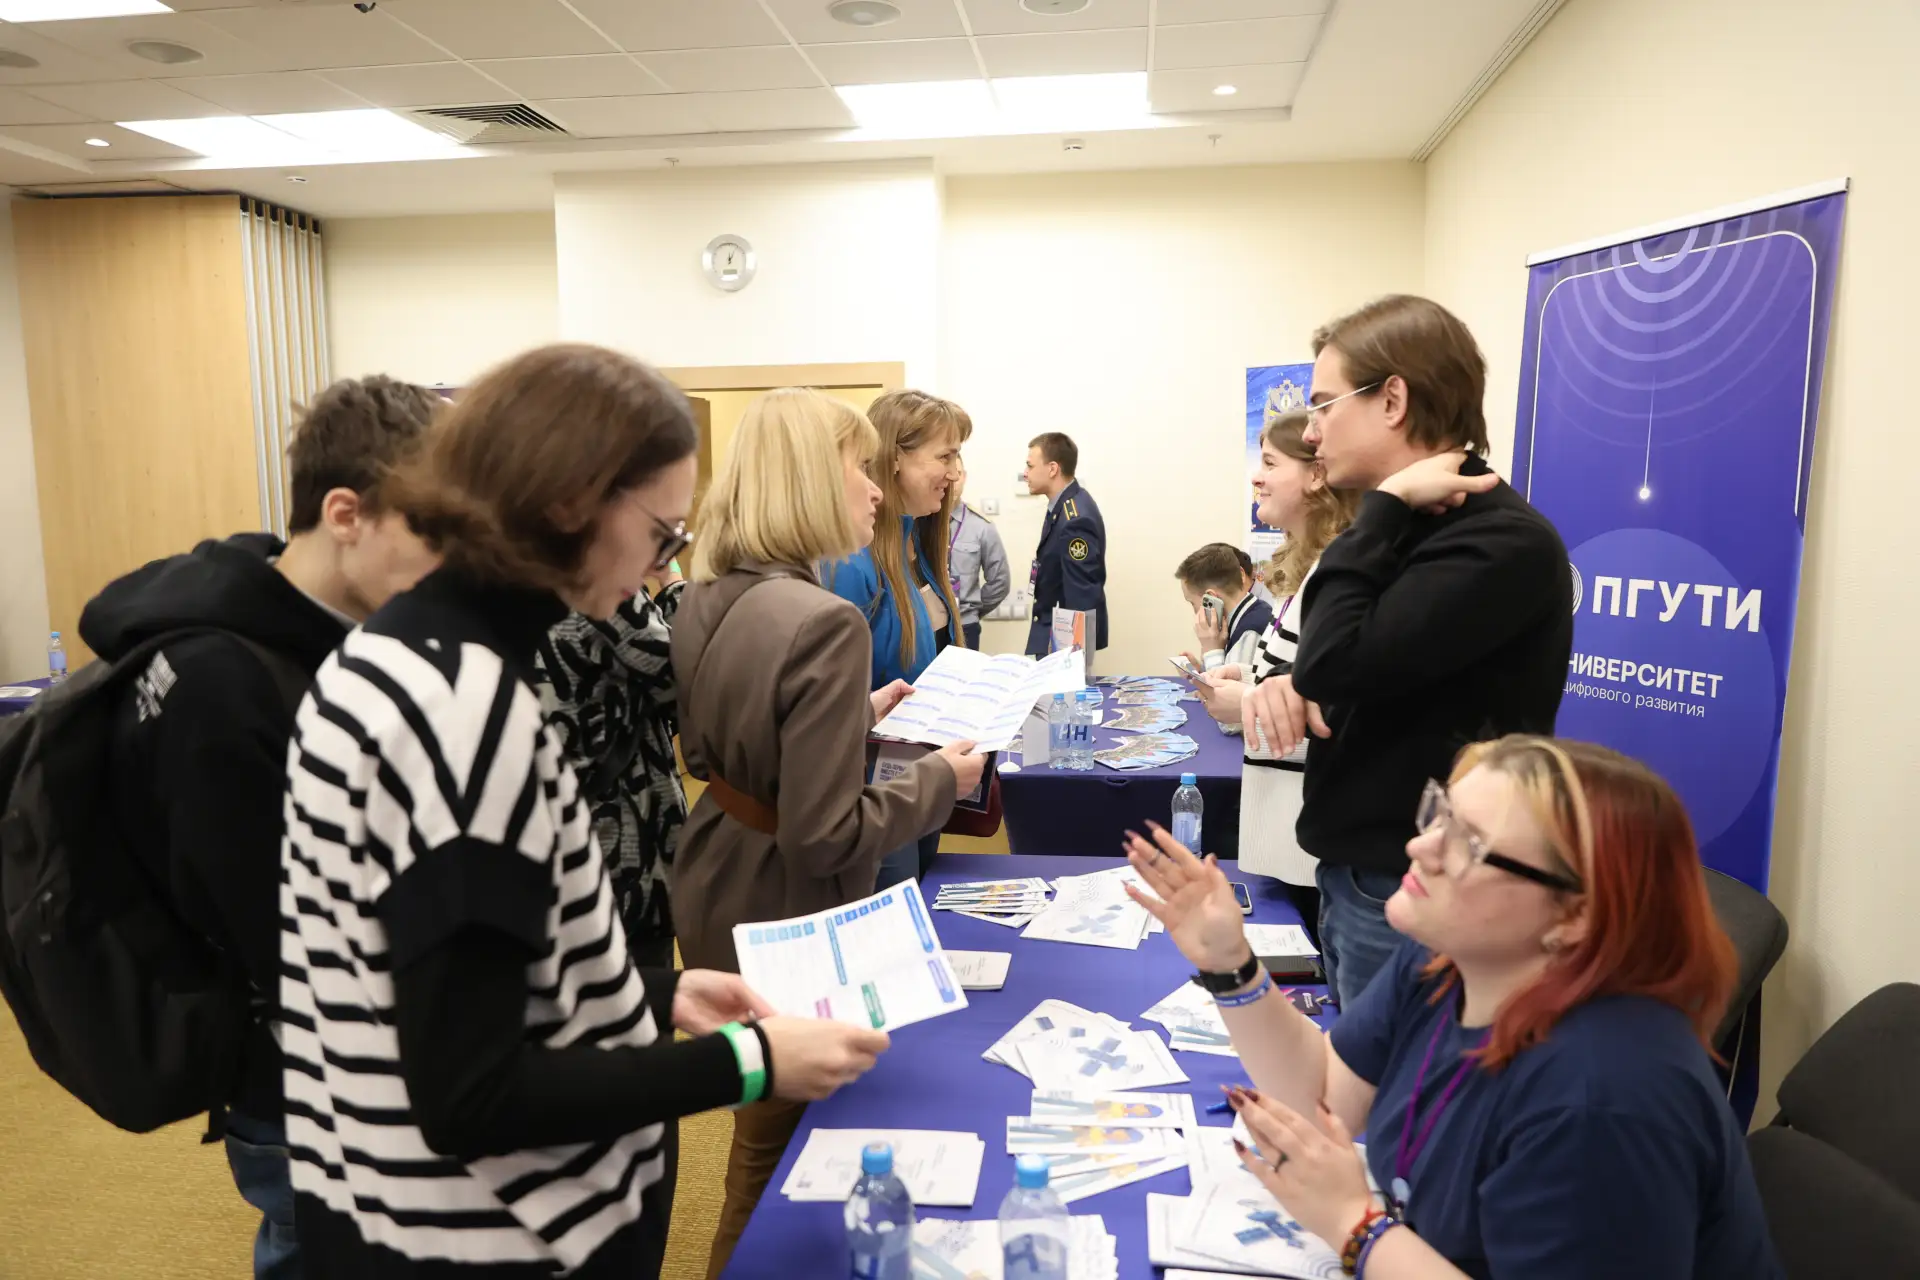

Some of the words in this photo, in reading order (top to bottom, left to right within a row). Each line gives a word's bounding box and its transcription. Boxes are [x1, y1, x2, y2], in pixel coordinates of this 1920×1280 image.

[1592, 575, 1762, 633] ПГУТИ
[1568, 652, 1724, 699] НИВЕРСИТЕТ
[1635, 694, 1705, 718] развития
